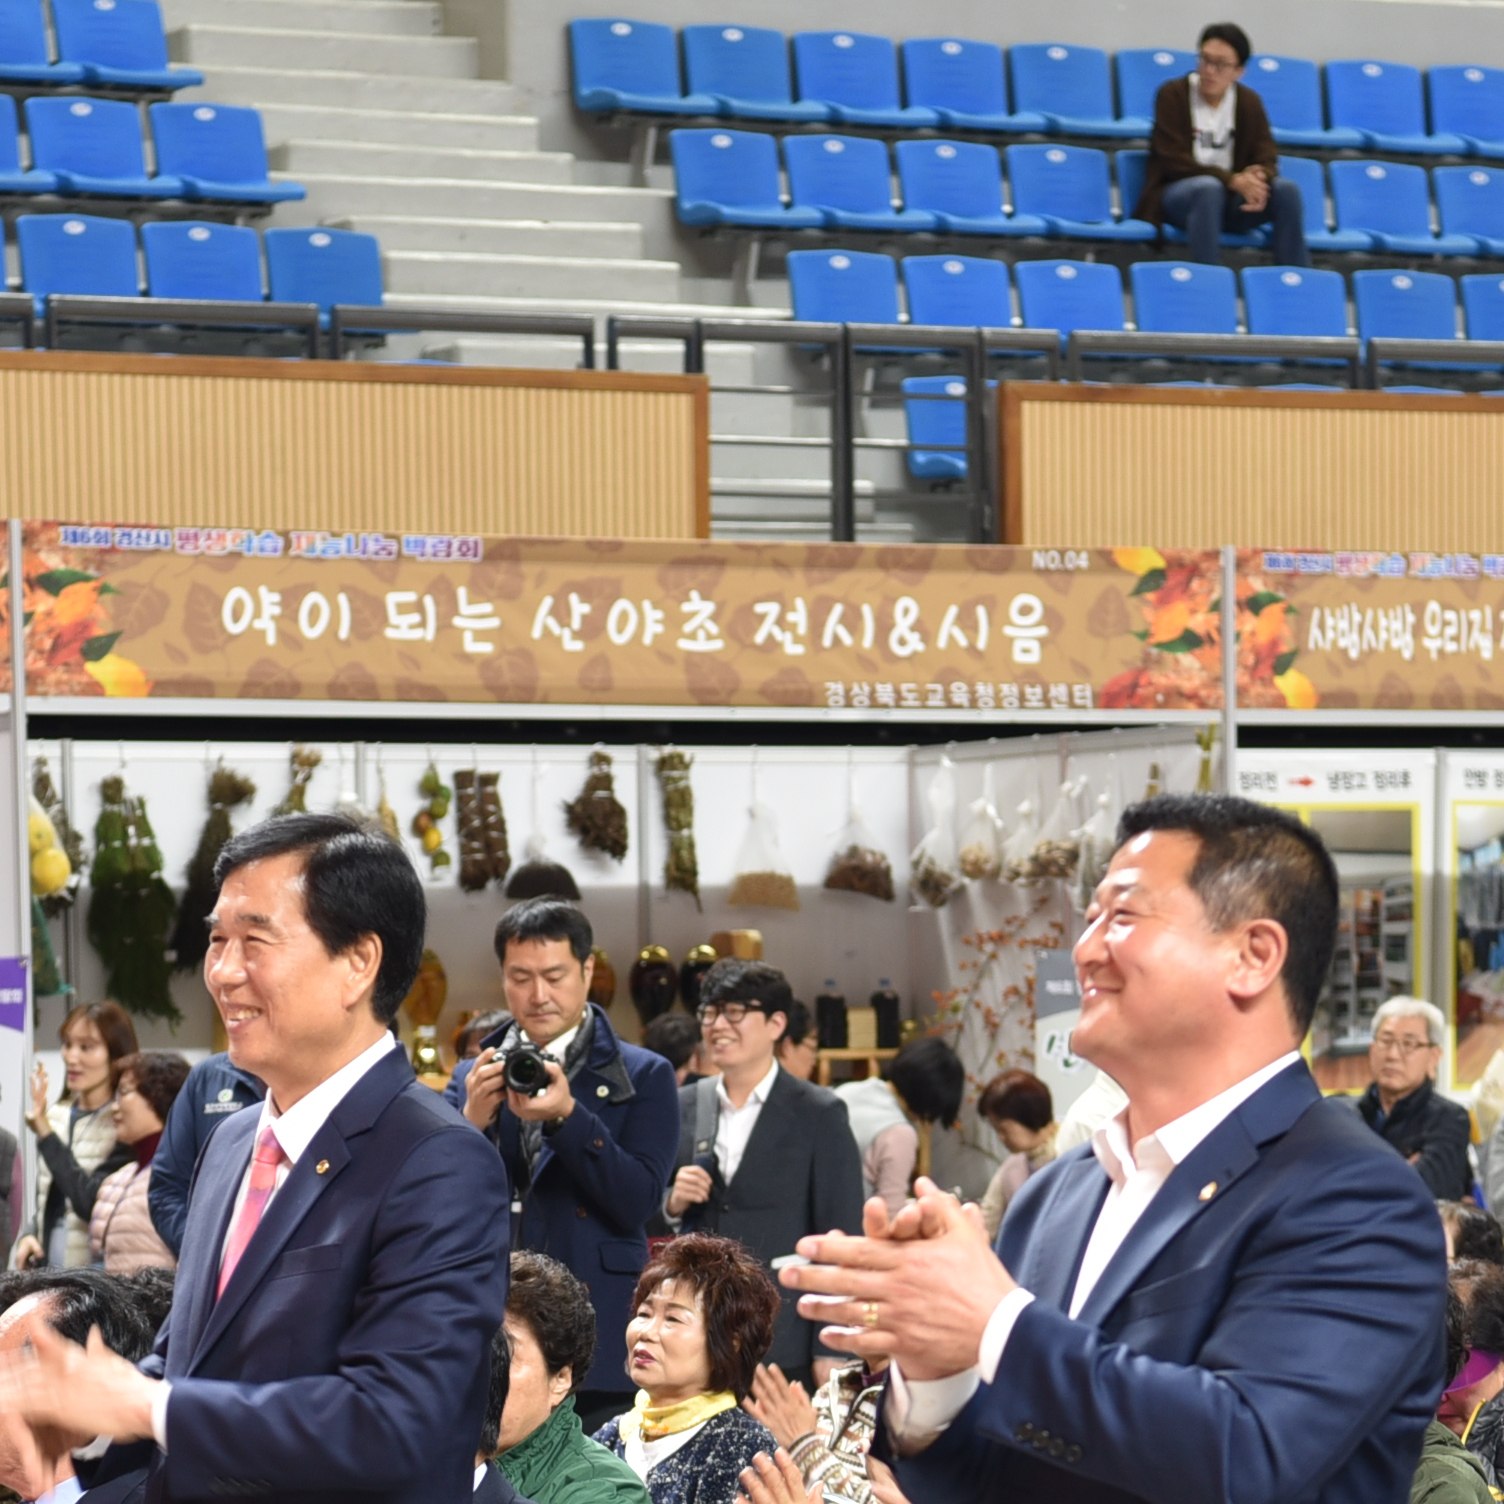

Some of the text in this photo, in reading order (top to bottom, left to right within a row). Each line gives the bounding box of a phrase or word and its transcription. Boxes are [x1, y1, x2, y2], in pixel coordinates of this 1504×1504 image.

[174, 529, 284, 557] 평생학습
[289, 531, 397, 559] 재능나눔
[401, 535, 483, 562] 박람회
[1032, 550, 1089, 571] NO.04
[221, 585, 351, 646] 약이
[384, 586, 501, 653] 되는
[753, 592, 1049, 664] 전시&시음
[1308, 602, 1416, 661] 샤방샤방
[1421, 599, 1493, 661] 우리집
[824, 681, 1095, 709] 경상북도교육청정보센터
